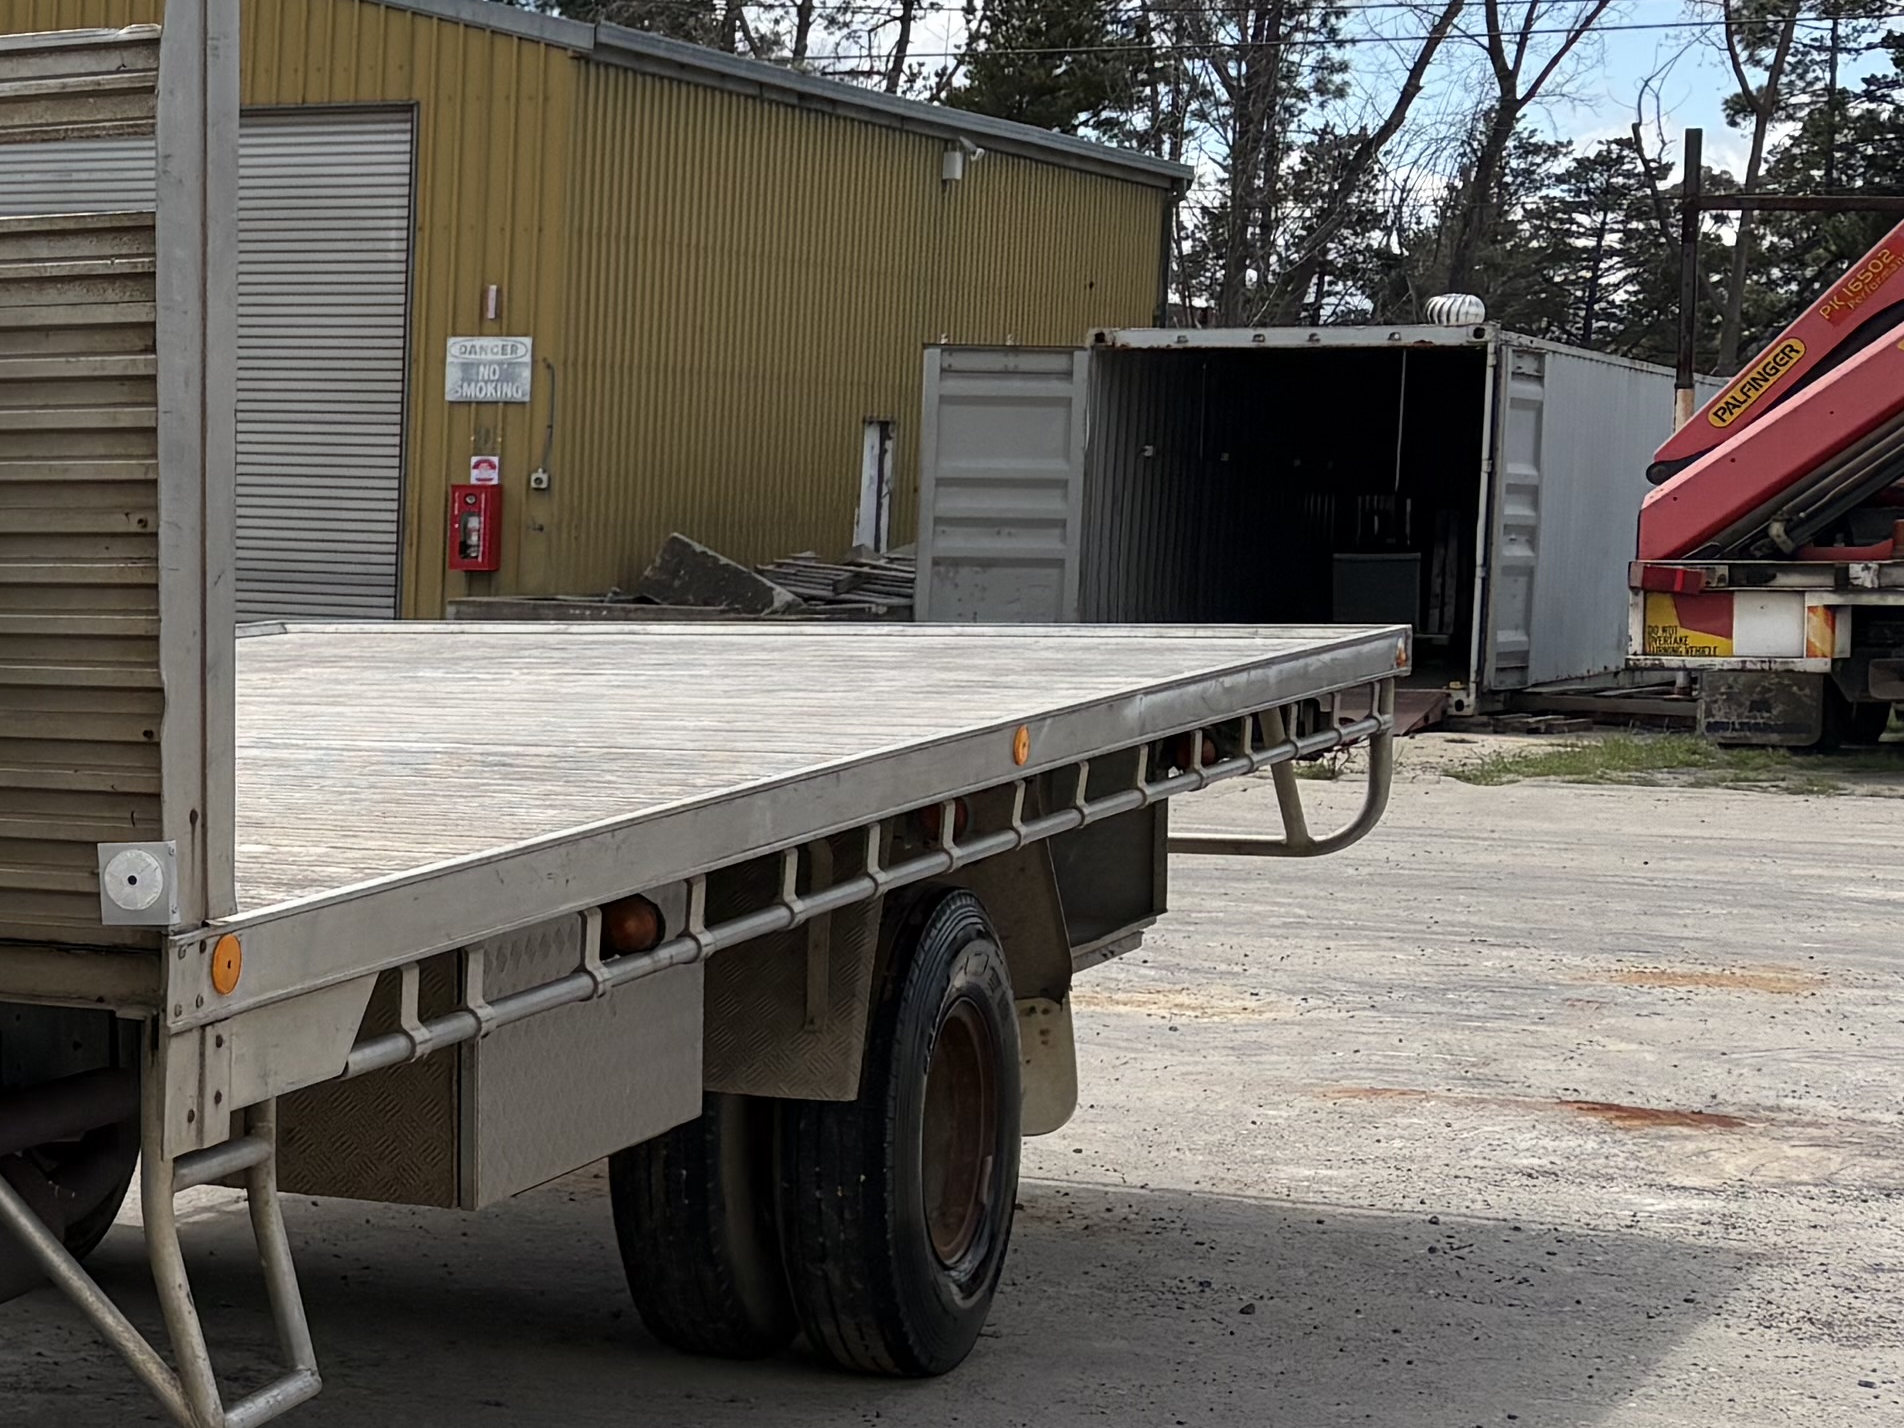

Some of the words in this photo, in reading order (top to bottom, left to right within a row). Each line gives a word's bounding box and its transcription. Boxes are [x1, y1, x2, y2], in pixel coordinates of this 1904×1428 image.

[1819, 296, 1846, 319] PK
[1842, 249, 1895, 297] 16502
[1847, 253, 1904, 310] Performan
[458, 344, 519, 357] DANGER
[453, 381, 523, 399] SMOKING
[478, 363, 500, 381] NO
[1712, 343, 1801, 423] PALFINGER
